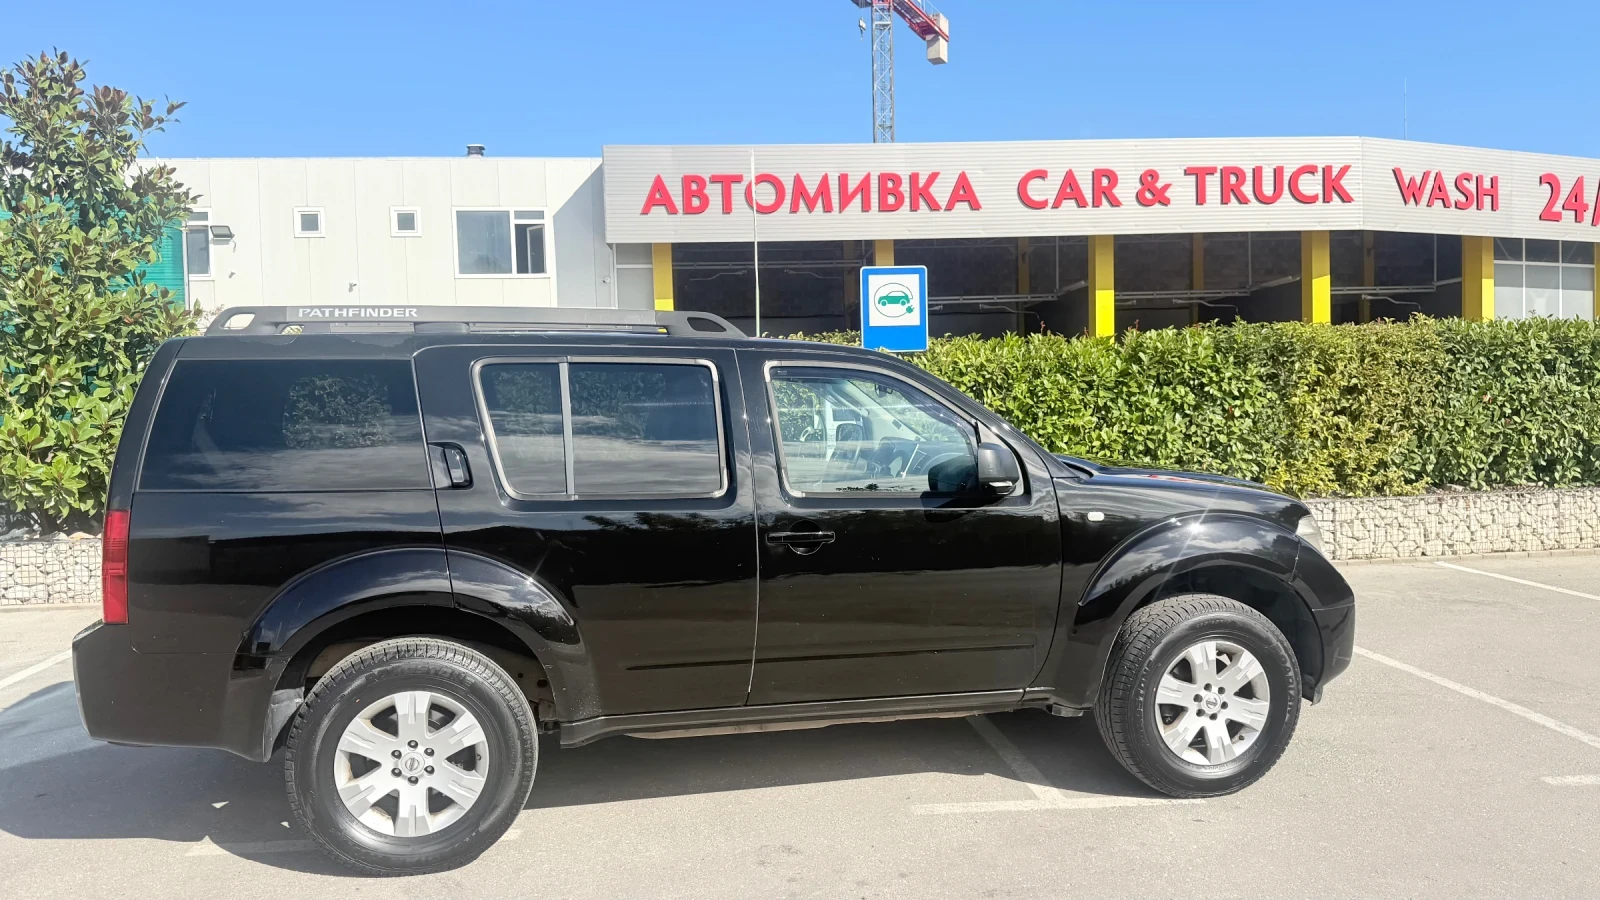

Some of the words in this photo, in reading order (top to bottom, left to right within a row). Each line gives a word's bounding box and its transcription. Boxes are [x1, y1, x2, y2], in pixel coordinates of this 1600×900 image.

[641, 171, 982, 214] АВТОМИВКА
[1018, 168, 1123, 209] CAR
[1136, 169, 1172, 207] &
[1185, 164, 1355, 205] TRUCK
[1393, 167, 1500, 211] WASH
[298, 308, 418, 318] PATHFINDER
